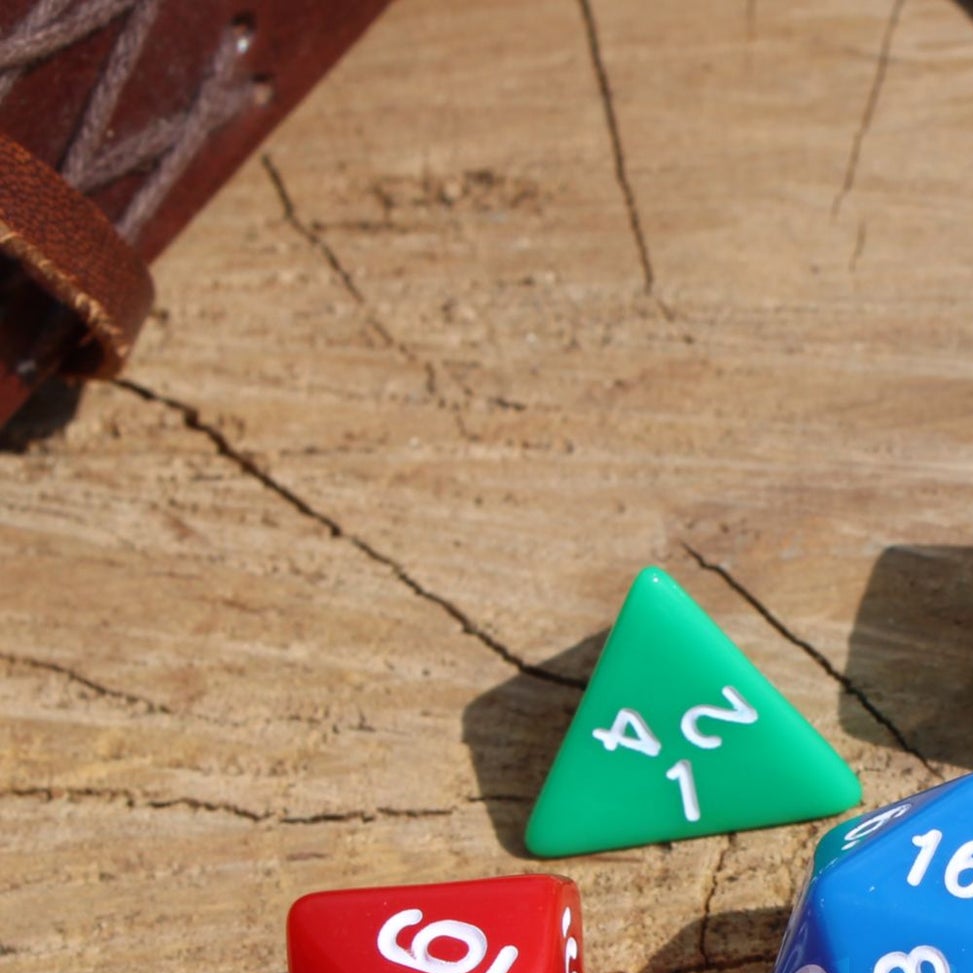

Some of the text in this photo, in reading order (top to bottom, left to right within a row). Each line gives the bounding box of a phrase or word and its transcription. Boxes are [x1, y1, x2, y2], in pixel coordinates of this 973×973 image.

[592, 708, 662, 757] 4
[680, 685, 759, 750] 2
[666, 759, 701, 822] 1
